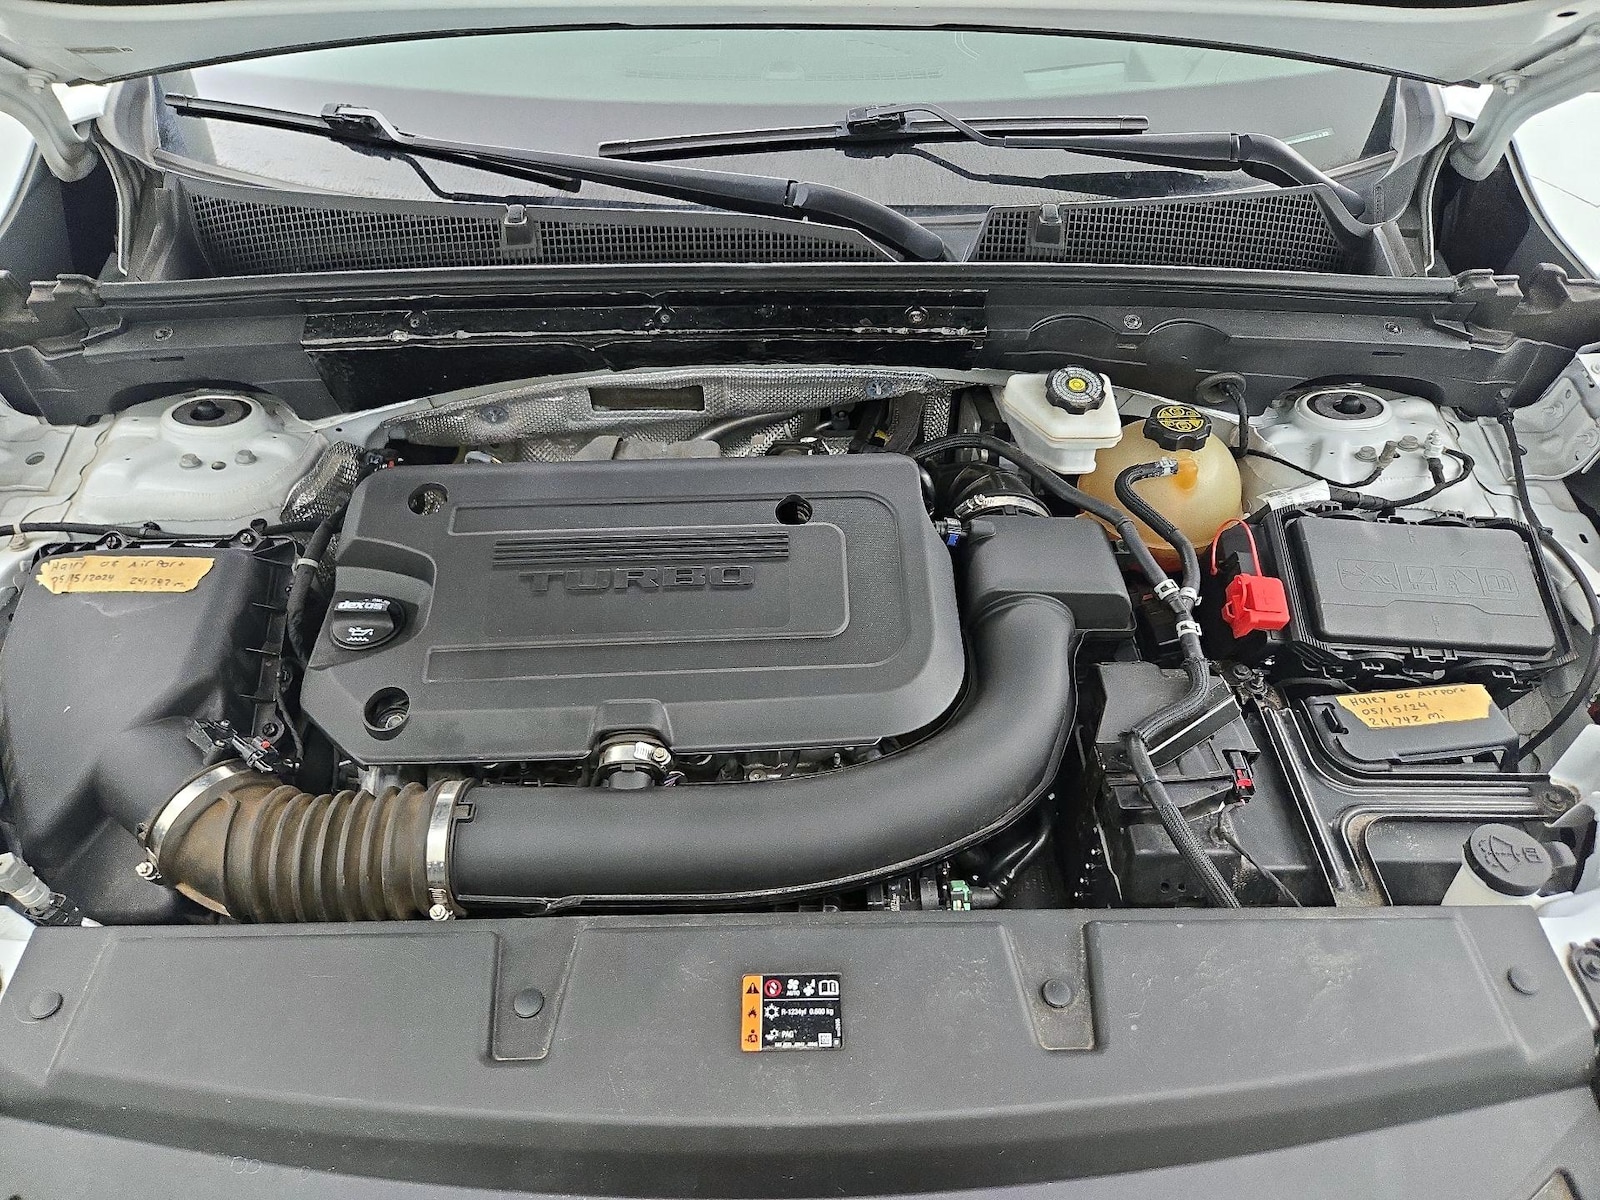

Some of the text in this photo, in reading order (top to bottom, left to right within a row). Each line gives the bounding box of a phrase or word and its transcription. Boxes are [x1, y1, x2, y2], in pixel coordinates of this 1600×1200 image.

[518, 565, 756, 592] TURBO
[337, 599, 384, 610] dexos
[1361, 701, 1430, 716] 05/15/24
[1368, 714, 1422, 727] 24,742
